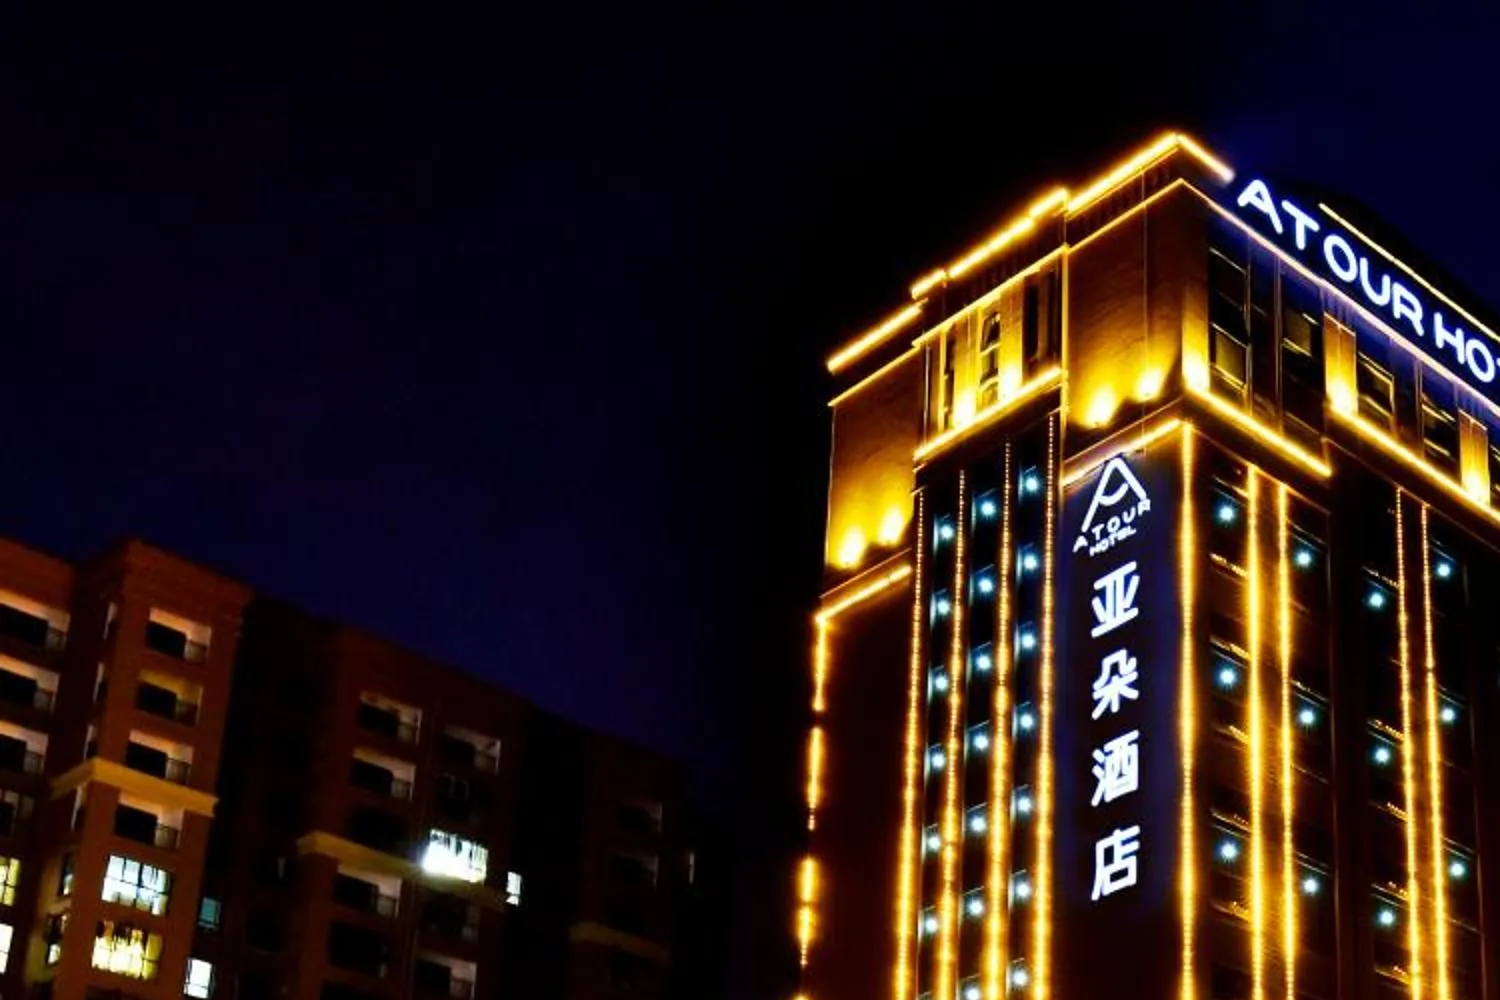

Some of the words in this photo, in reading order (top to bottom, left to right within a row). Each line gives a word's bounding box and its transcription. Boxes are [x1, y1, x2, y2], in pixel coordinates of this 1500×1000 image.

[1238, 179, 1424, 336] ATOUR
[1072, 499, 1151, 553] ATOUR
[1089, 525, 1137, 557] HOTEL
[1090, 560, 1141, 902] 亚朵酒店
